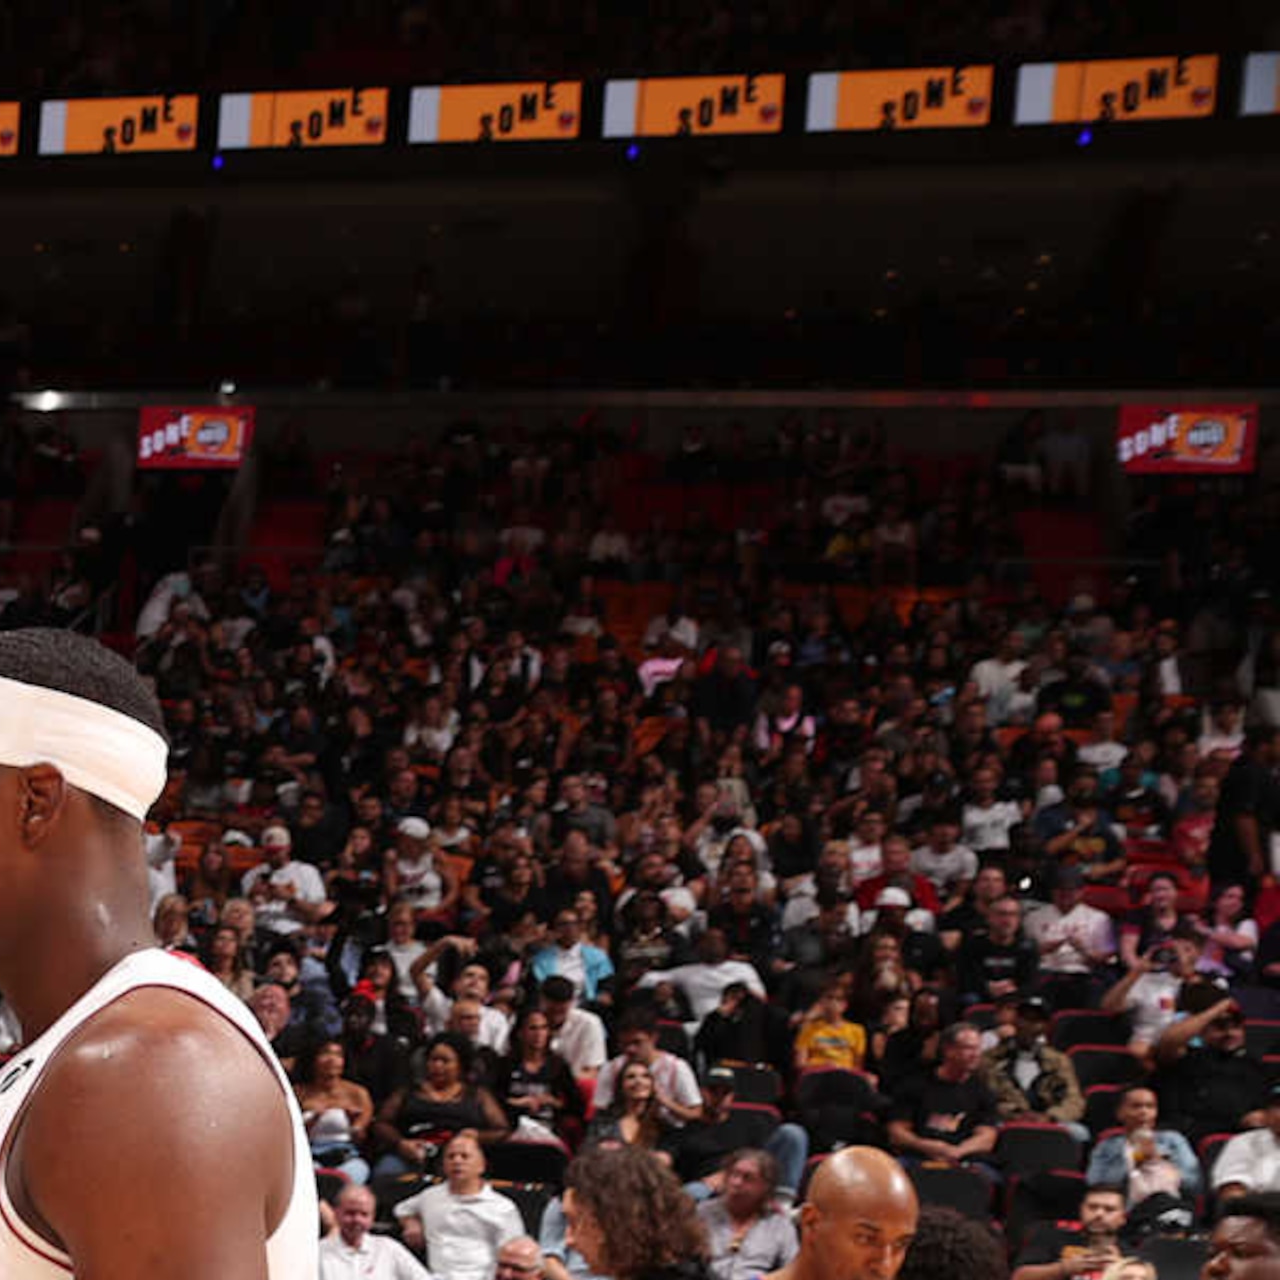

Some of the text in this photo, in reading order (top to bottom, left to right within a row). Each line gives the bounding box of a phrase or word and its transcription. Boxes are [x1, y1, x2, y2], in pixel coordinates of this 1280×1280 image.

[290, 88, 362, 146] SOME
[478, 81, 555, 139] SOME
[677, 75, 757, 135] SOME
[881, 66, 964, 131] SOME
[1100, 57, 1190, 120] SOME
[102, 95, 174, 154] SOME
